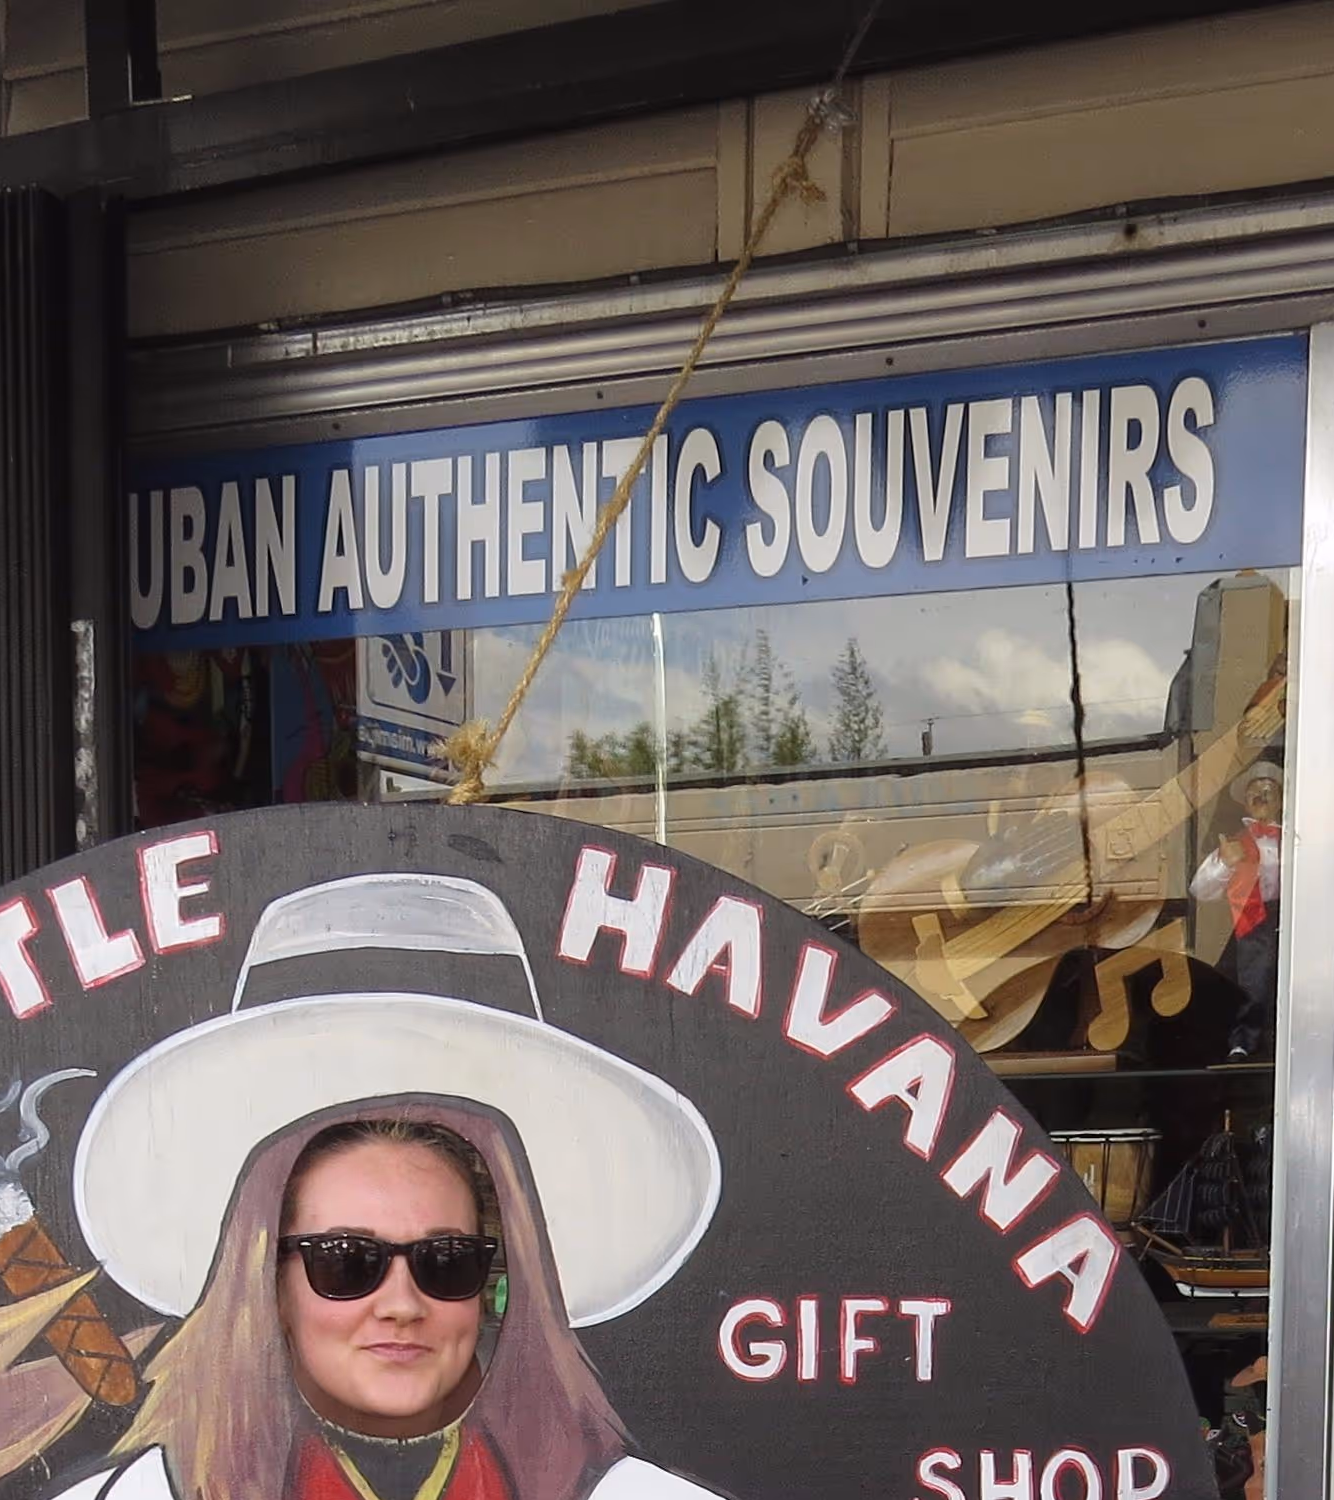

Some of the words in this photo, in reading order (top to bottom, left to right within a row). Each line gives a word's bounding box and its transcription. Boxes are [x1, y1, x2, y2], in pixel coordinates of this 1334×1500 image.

[317, 426, 723, 616] AUTHENTIC
[745, 376, 1218, 578] SOUVENIRS
[557, 842, 1125, 1337] HAVANA
[717, 1296, 952, 1386] GIFT
